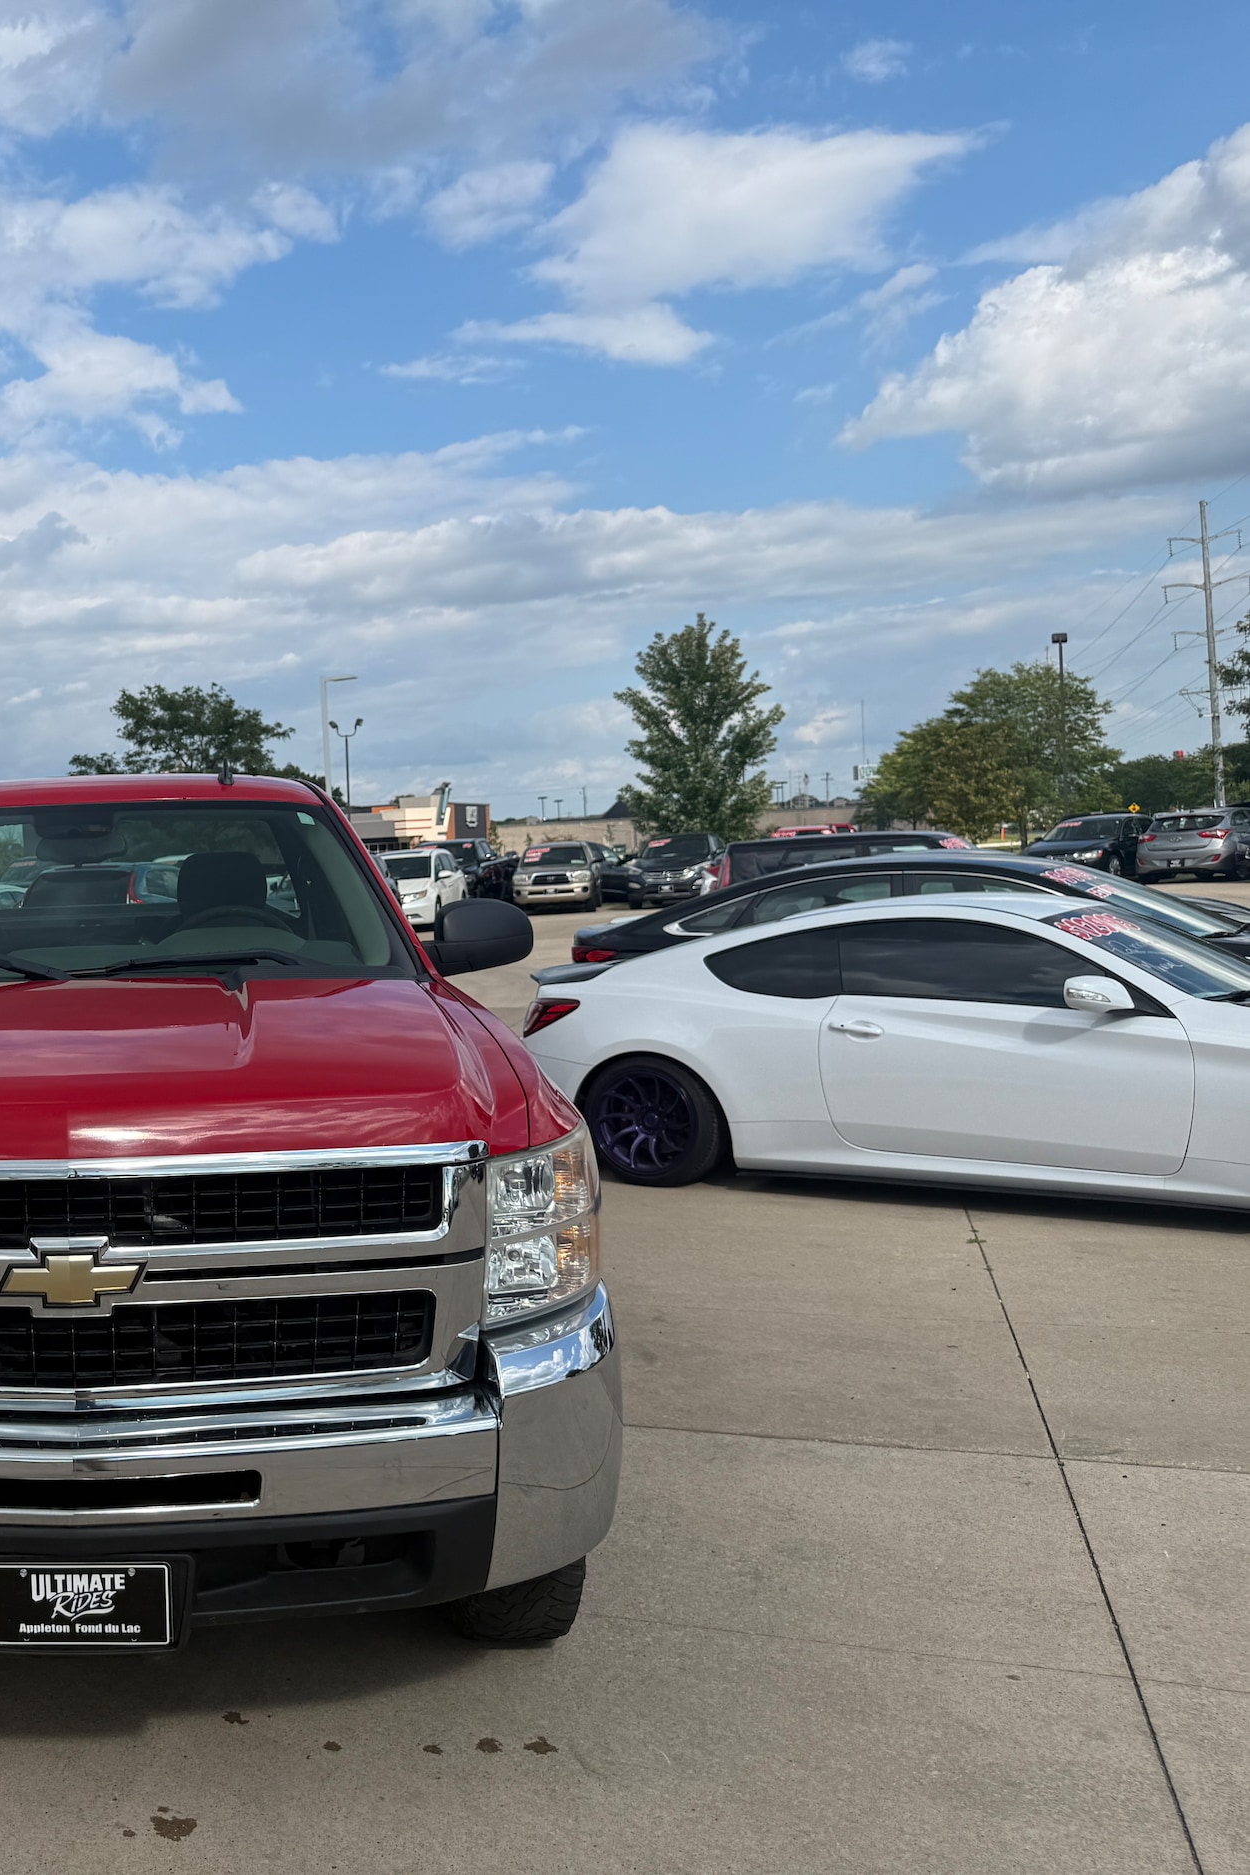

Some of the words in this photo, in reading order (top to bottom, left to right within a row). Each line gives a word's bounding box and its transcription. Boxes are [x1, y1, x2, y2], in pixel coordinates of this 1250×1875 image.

[30, 1573, 125, 1602] ULTIMATE
[19, 1623, 70, 1634] Appleton
[75, 1623, 102, 1634] Fond
[104, 1623, 120, 1634] du
[121, 1623, 141, 1634] Lac
